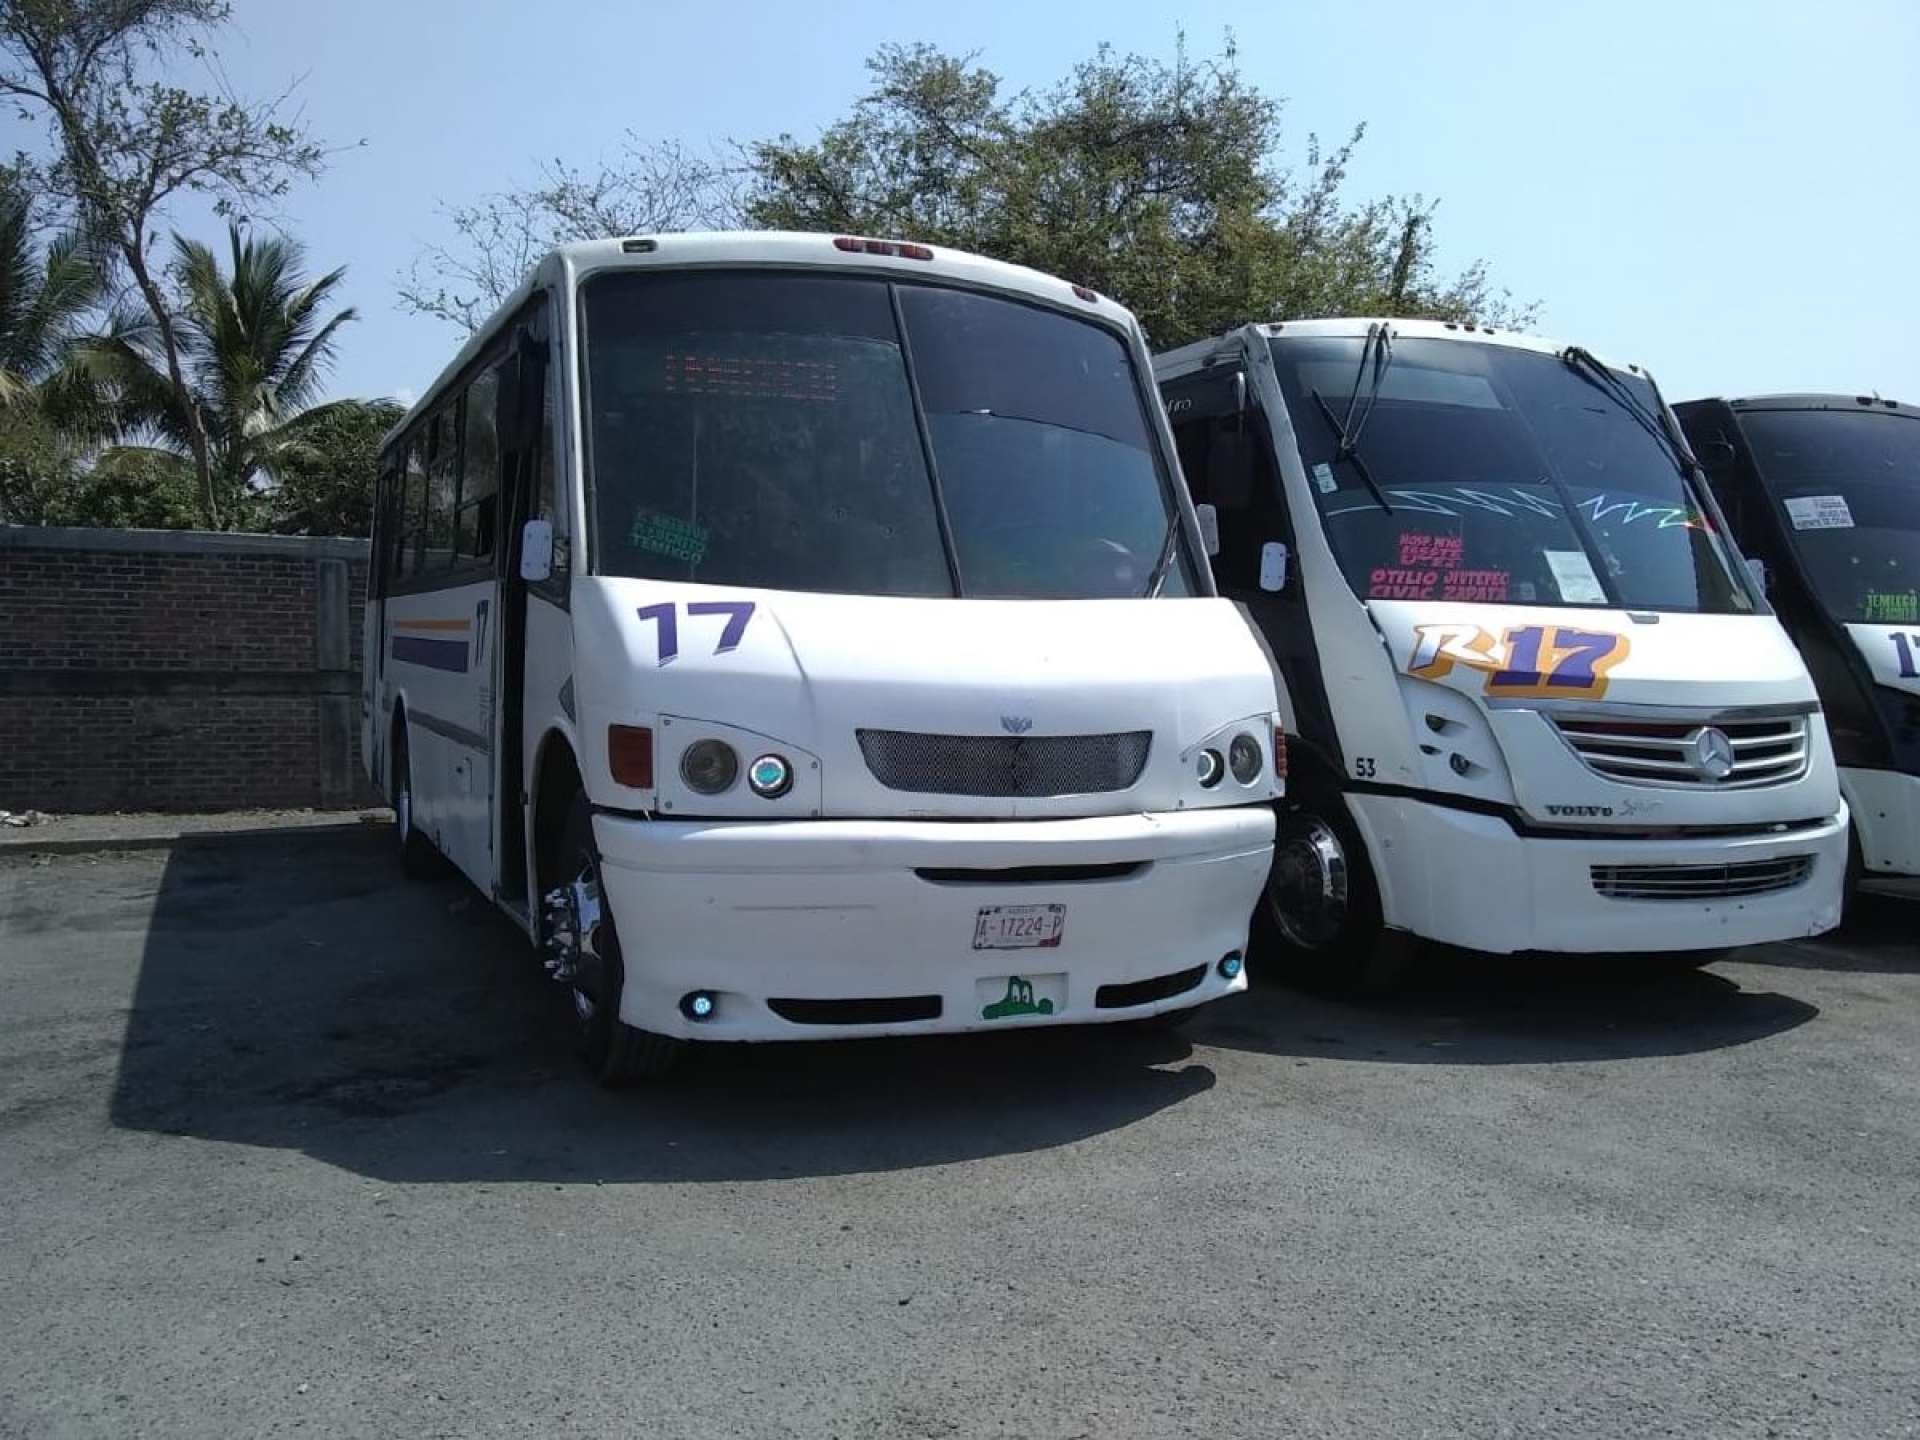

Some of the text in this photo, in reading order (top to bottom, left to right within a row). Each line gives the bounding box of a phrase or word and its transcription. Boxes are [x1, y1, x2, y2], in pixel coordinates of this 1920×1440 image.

[1371, 570, 1438, 584] OTILIO
[1370, 585, 1434, 599] CIVAC
[636, 601, 756, 667] 17
[1356, 756, 1376, 777] 53
[980, 916, 1061, 936] A-17224-P
